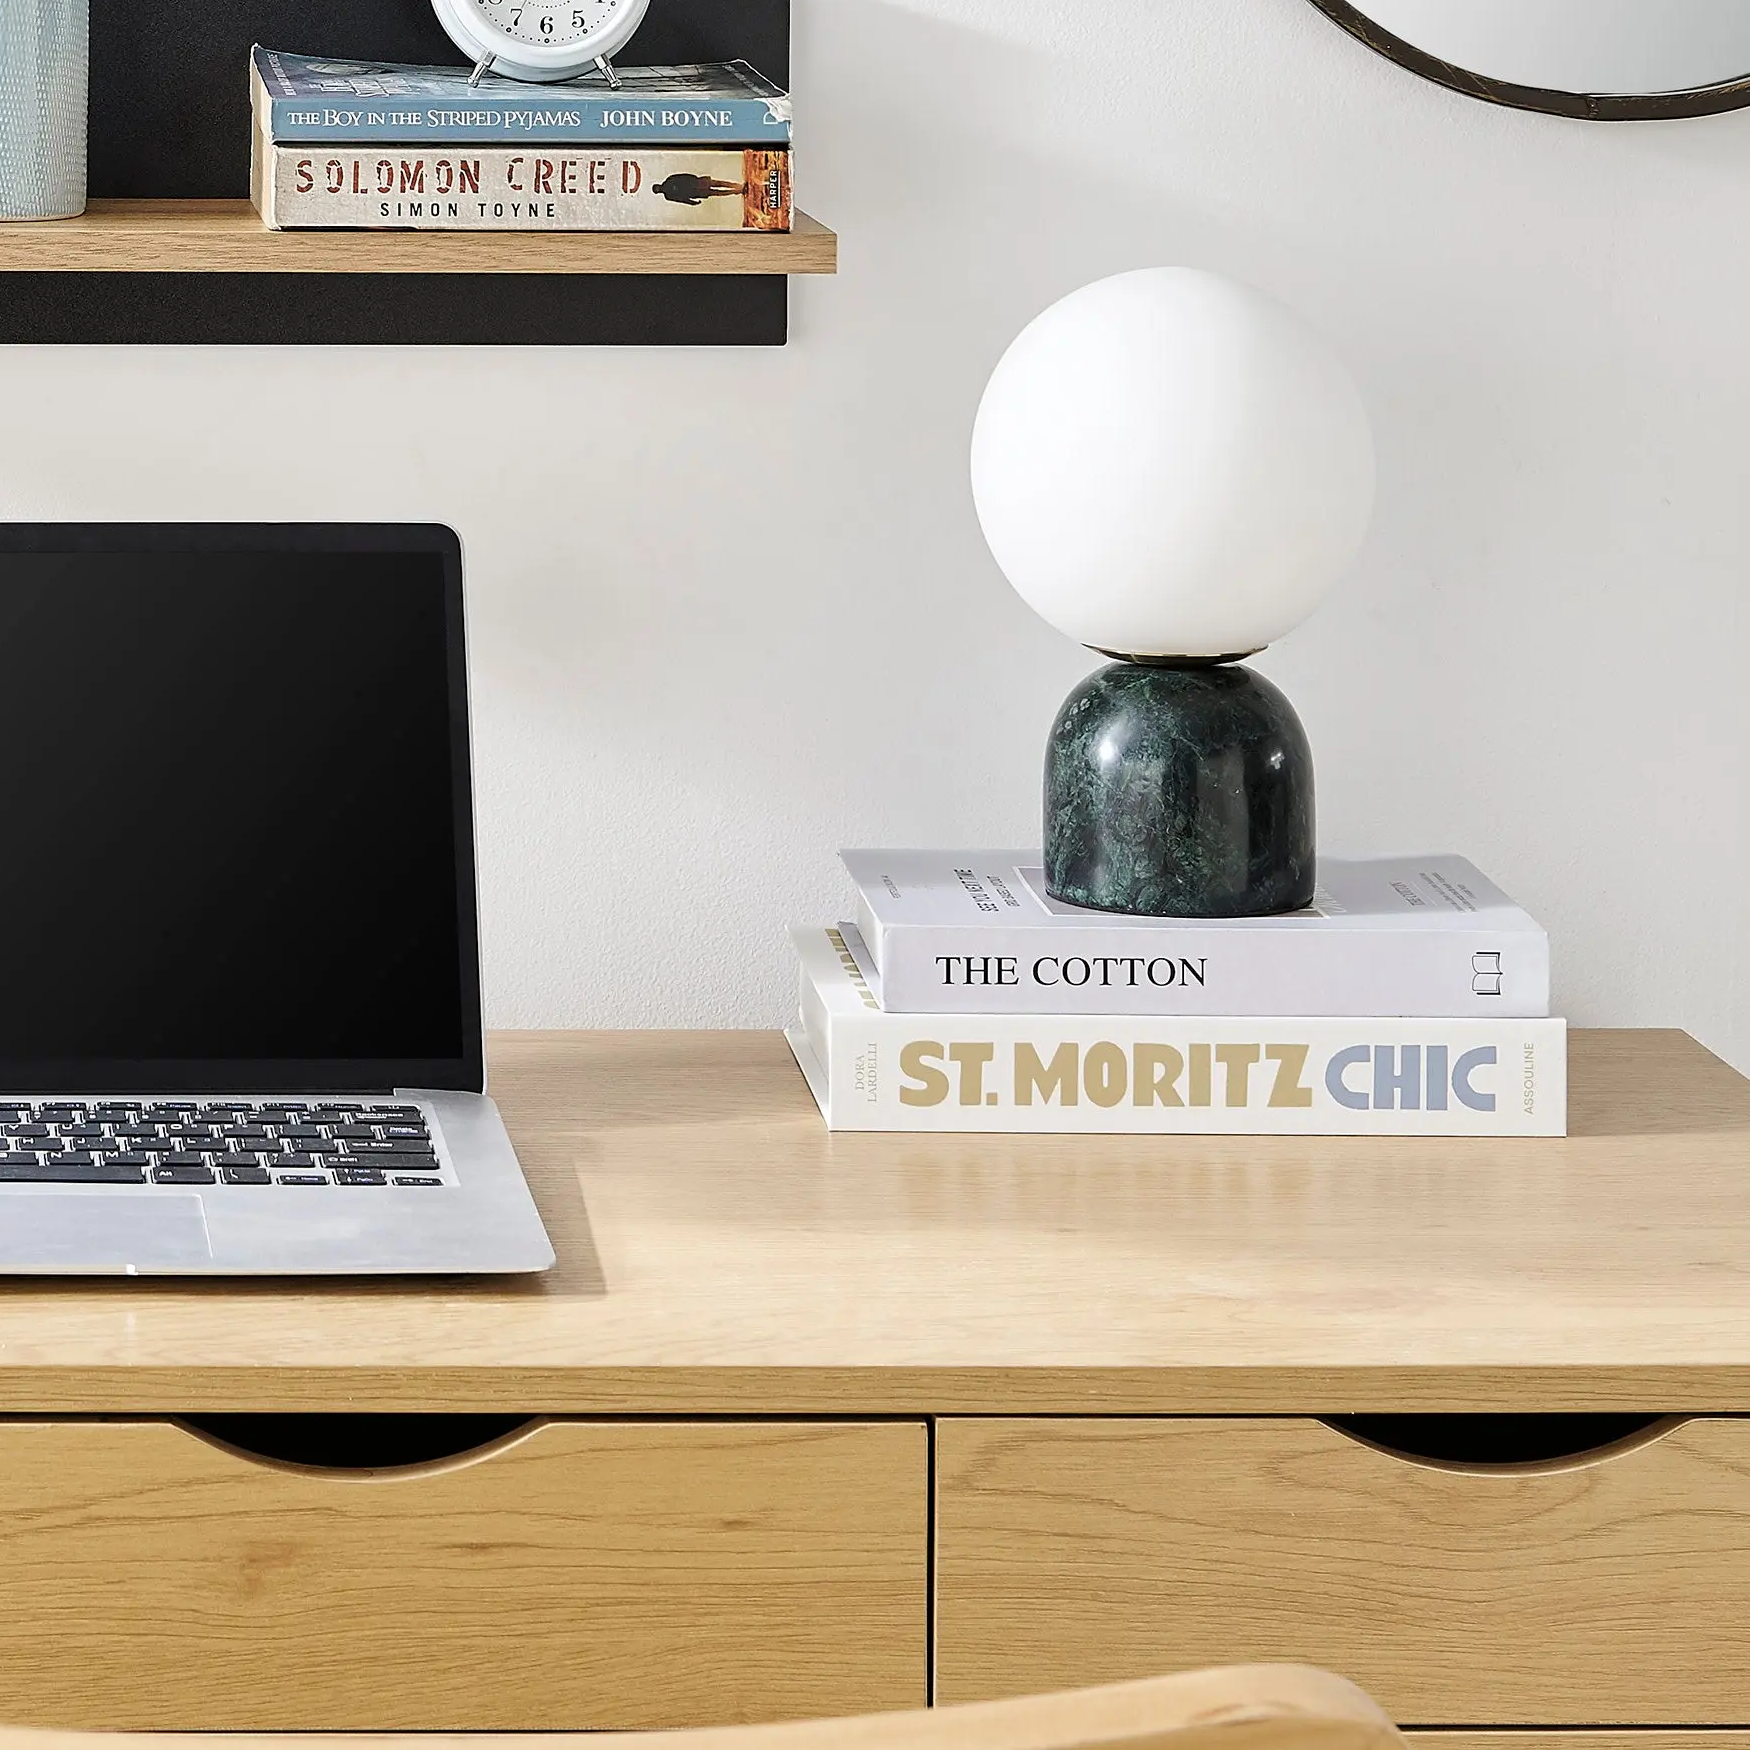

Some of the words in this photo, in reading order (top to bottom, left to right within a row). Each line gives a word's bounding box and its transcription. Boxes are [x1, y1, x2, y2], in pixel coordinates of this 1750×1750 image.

[510, 8, 523, 26] 7
[539, 15, 554, 34] 6
[571, 9, 585, 28] 5
[287, 112, 321, 125] THE
[322, 109, 364, 127] BOY
[367, 112, 386, 125] IN
[388, 112, 422, 125] THE
[427, 109, 501, 127] STRIPED
[503, 111, 581, 130] PYJAMAS
[599, 110, 655, 128] JOHN
[661, 110, 733, 127] BOYNE
[295, 159, 480, 194] SOLOMON
[506, 157, 642, 194] CREED
[769, 170, 778, 209] HARPER
[380, 202, 458, 217] SIMON
[477, 203, 555, 218] TOYNE
[935, 956, 1020, 986] THE
[1032, 956, 1208, 987] COTTON
[855, 1054, 865, 1090] DORA
[867, 1042, 878, 1102] LARDELLI
[899, 1040, 999, 1108] ST.
[1013, 1040, 1313, 1108] MORITZ
[1324, 1043, 1498, 1112] CHIC
[1523, 1042, 1535, 1116] ASSOULINE
